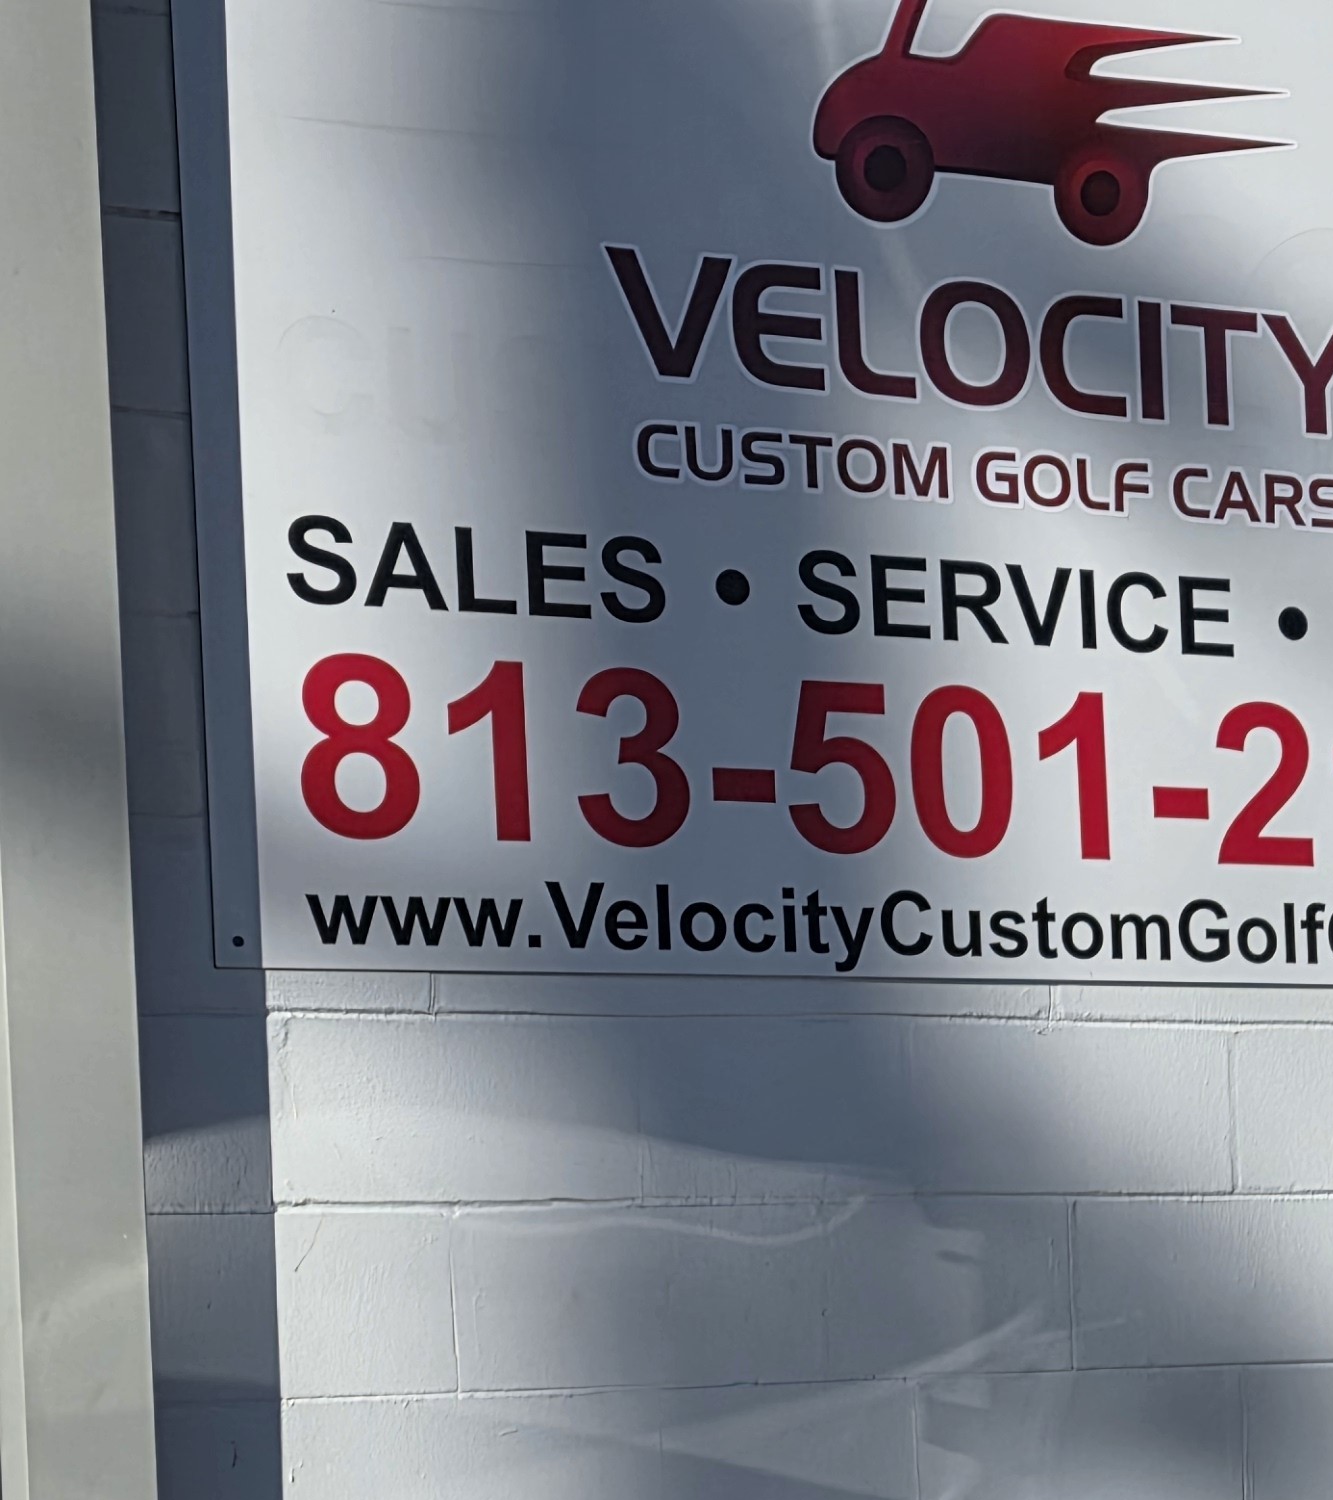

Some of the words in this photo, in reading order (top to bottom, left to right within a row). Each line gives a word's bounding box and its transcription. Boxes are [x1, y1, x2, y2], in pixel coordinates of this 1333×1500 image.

[638, 425, 948, 498] CUSTOM
[976, 452, 1148, 512] GOLF
[286, 515, 666, 623] SALES
[797, 550, 1235, 657] SERVICE
